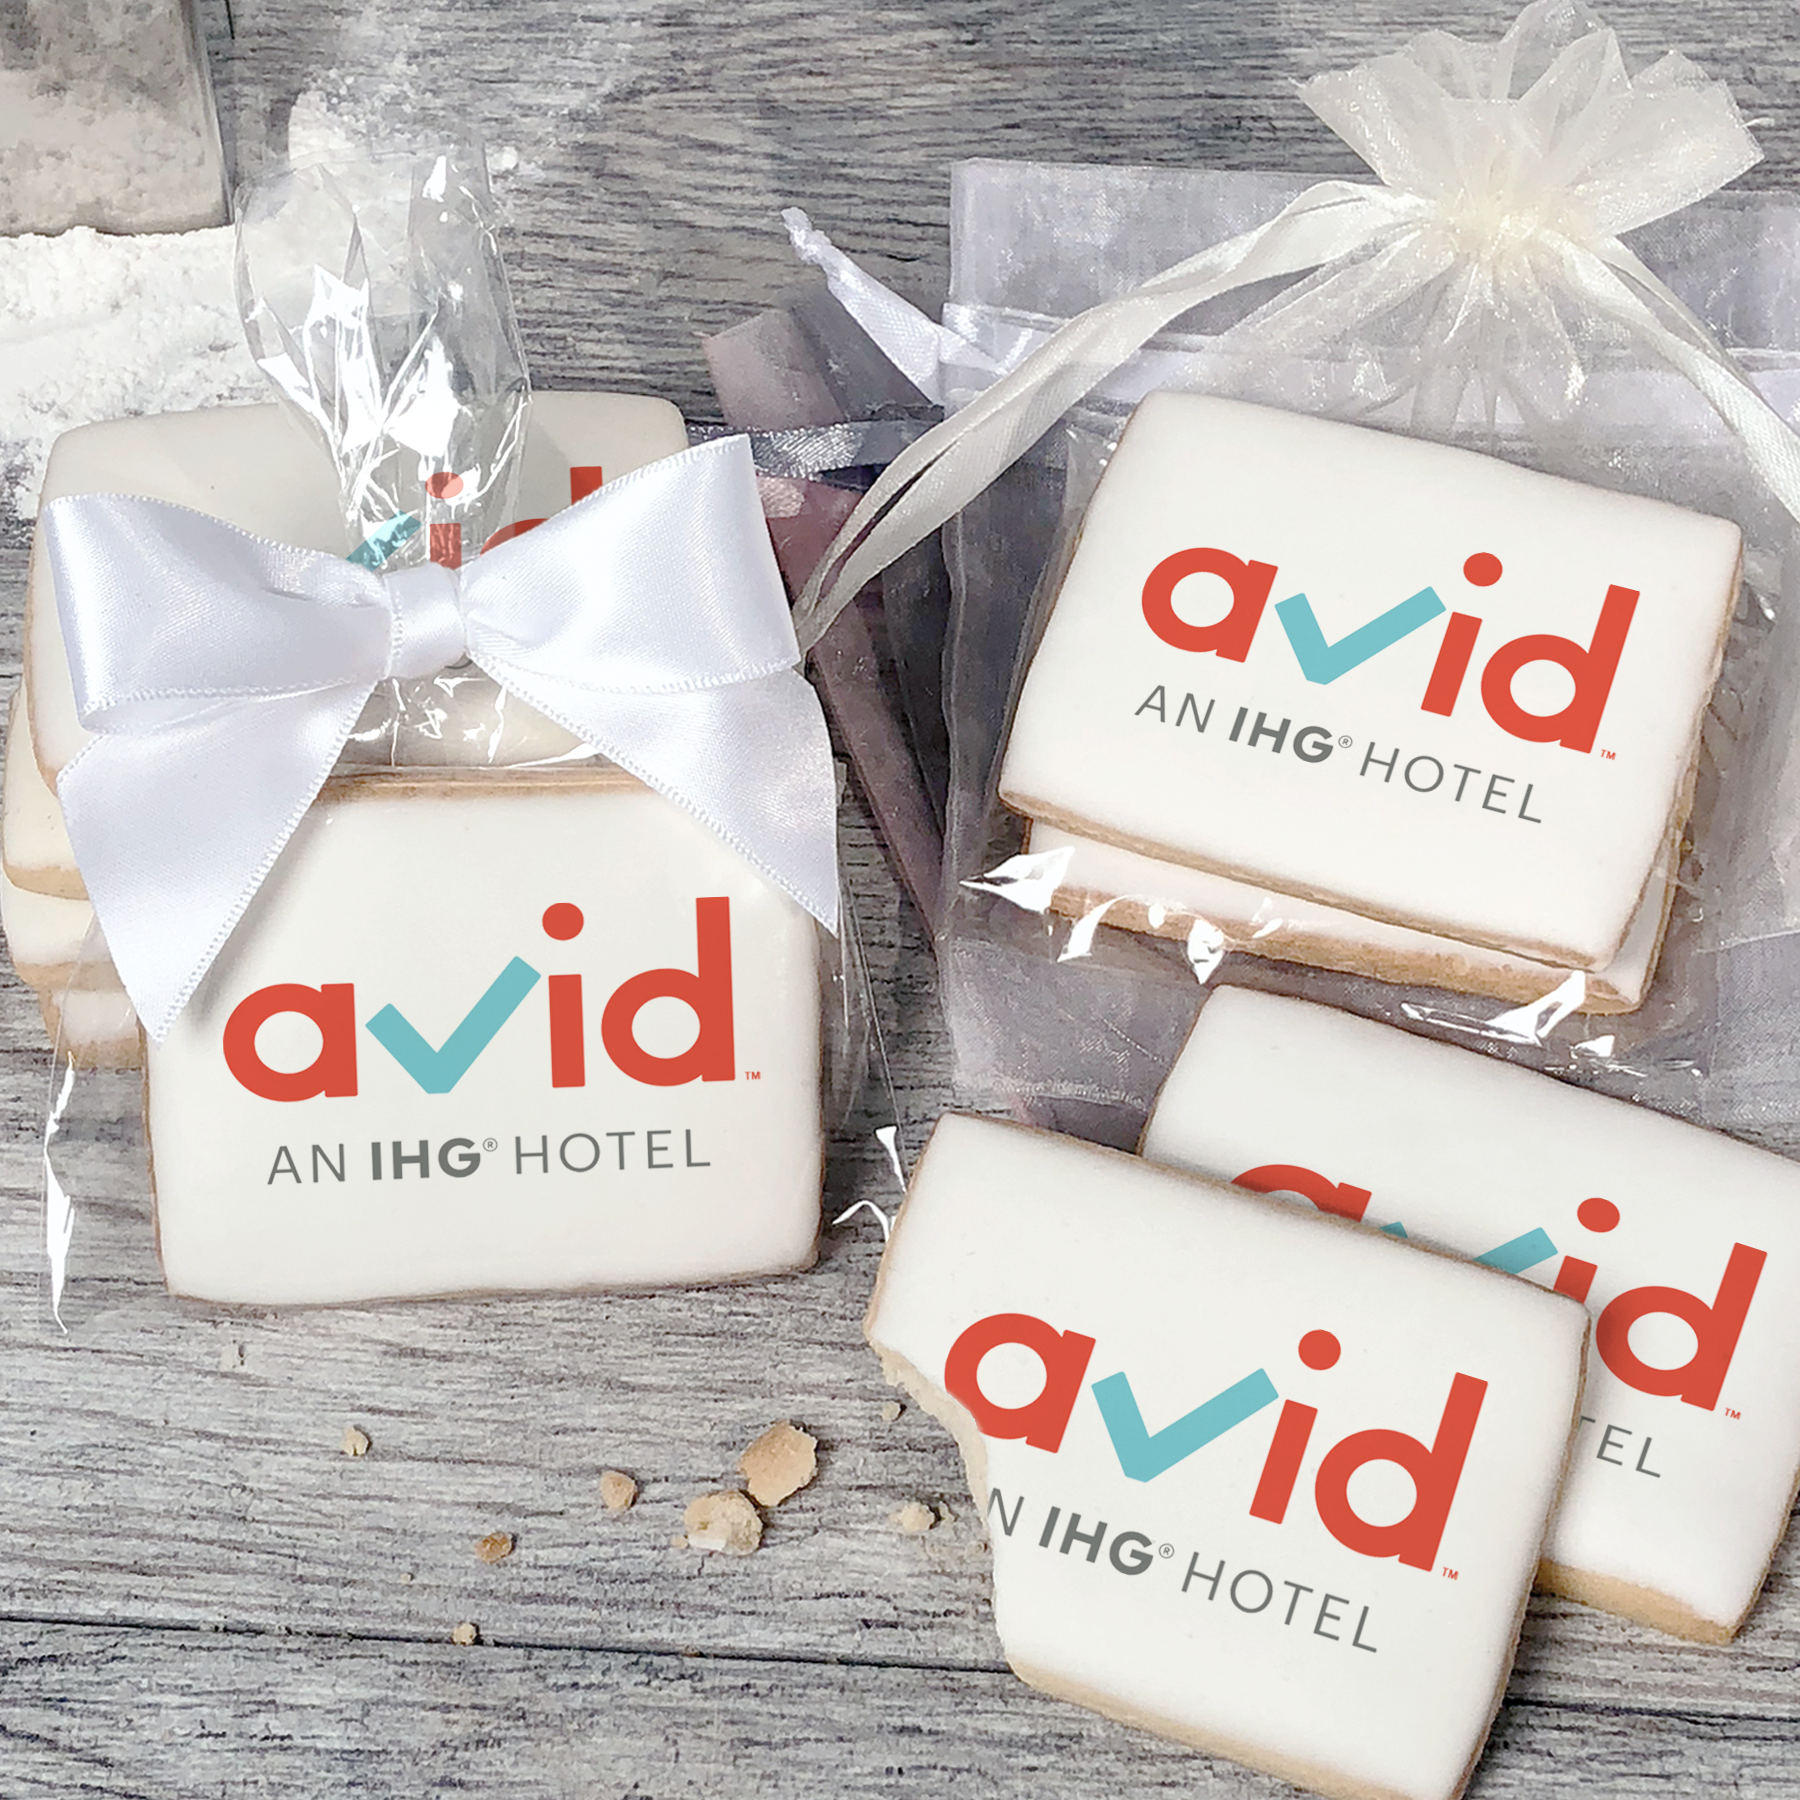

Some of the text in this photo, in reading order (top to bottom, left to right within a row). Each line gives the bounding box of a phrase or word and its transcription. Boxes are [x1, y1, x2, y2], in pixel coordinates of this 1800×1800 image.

[1135, 685, 1216, 733] AN
[1360, 742, 1542, 824] HOTEL
[268, 1144, 346, 1185] AN
[516, 1129, 711, 1175] HOTEL
[987, 1487, 1025, 1537] N
[1182, 1552, 1377, 1653] HOTEL
